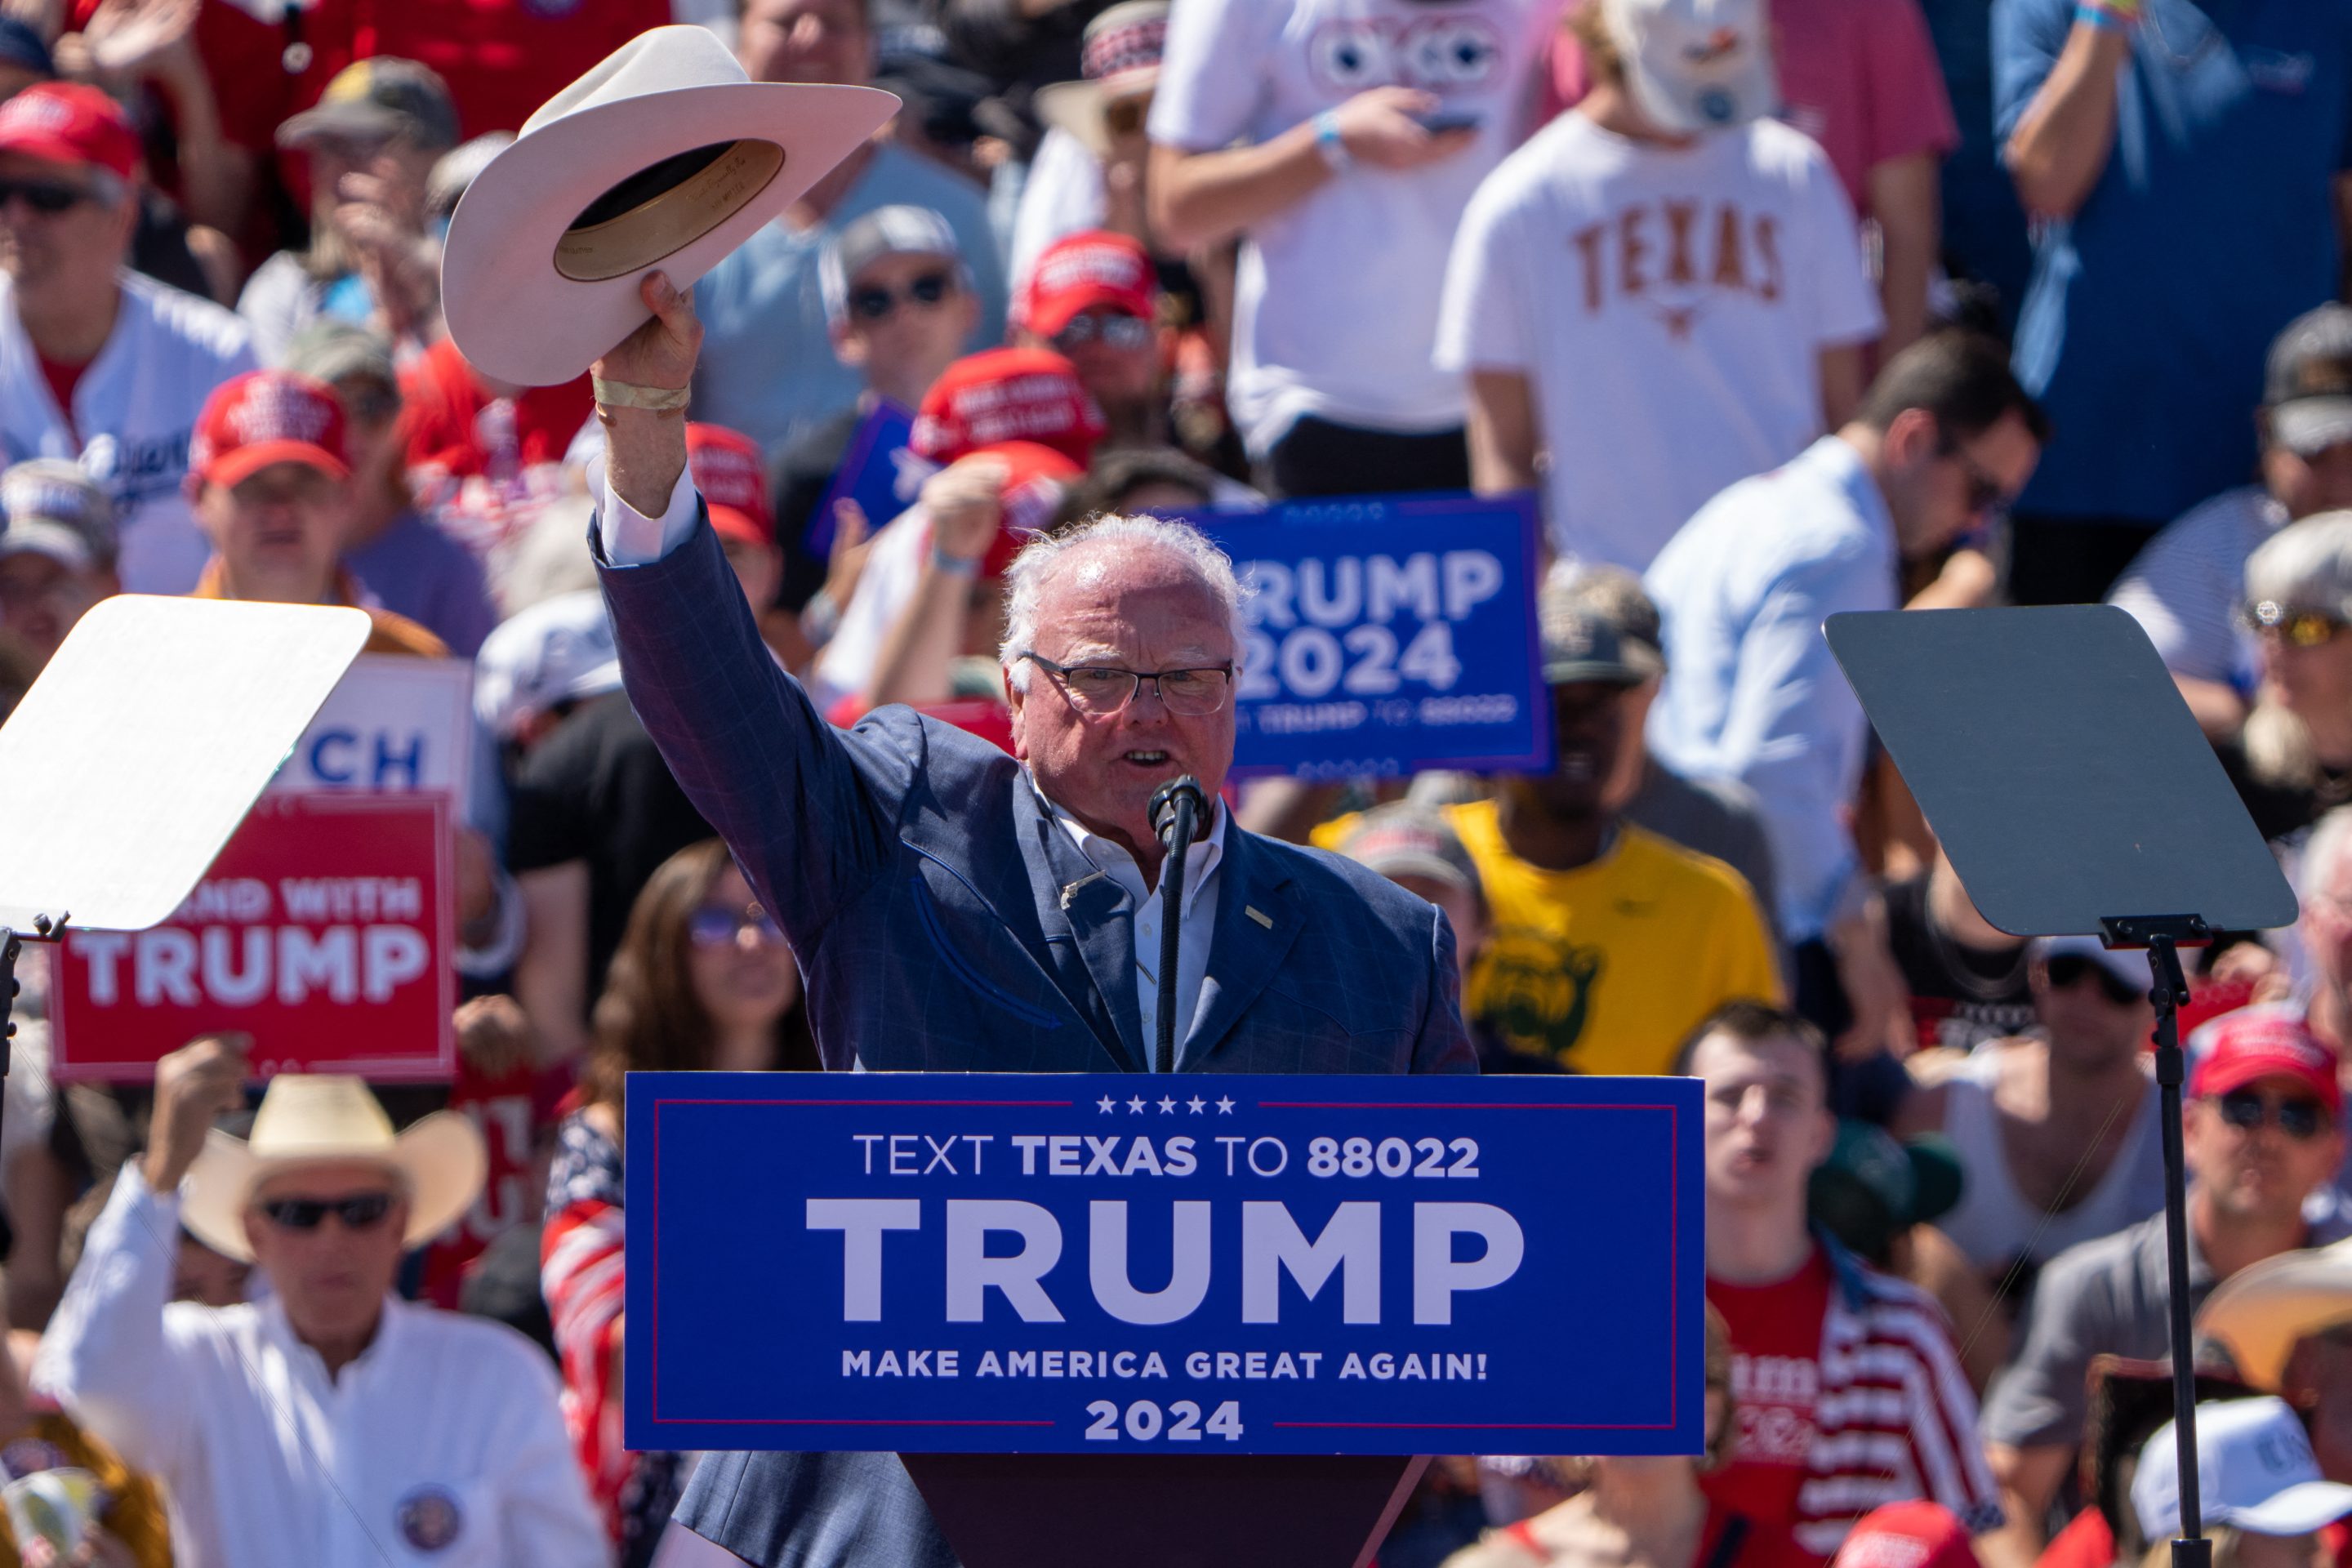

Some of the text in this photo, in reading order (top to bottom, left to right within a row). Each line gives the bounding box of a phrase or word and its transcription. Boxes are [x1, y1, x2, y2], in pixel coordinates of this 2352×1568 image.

[1571, 196, 1786, 315] TEXAS
[1235, 550, 1504, 628] RUMP
[1235, 621, 1461, 699] 2024
[280, 877, 421, 922] WITH
[70, 925, 430, 1008] TRUMP
[853, 1134, 1479, 1178] TEXT TEXAS TO 88022
[805, 1198, 1525, 1325] TRUMP
[841, 1350, 1487, 1380] MAKE AMERICA GREAT AGAIN!
[1084, 1399, 1244, 1441] 2024
